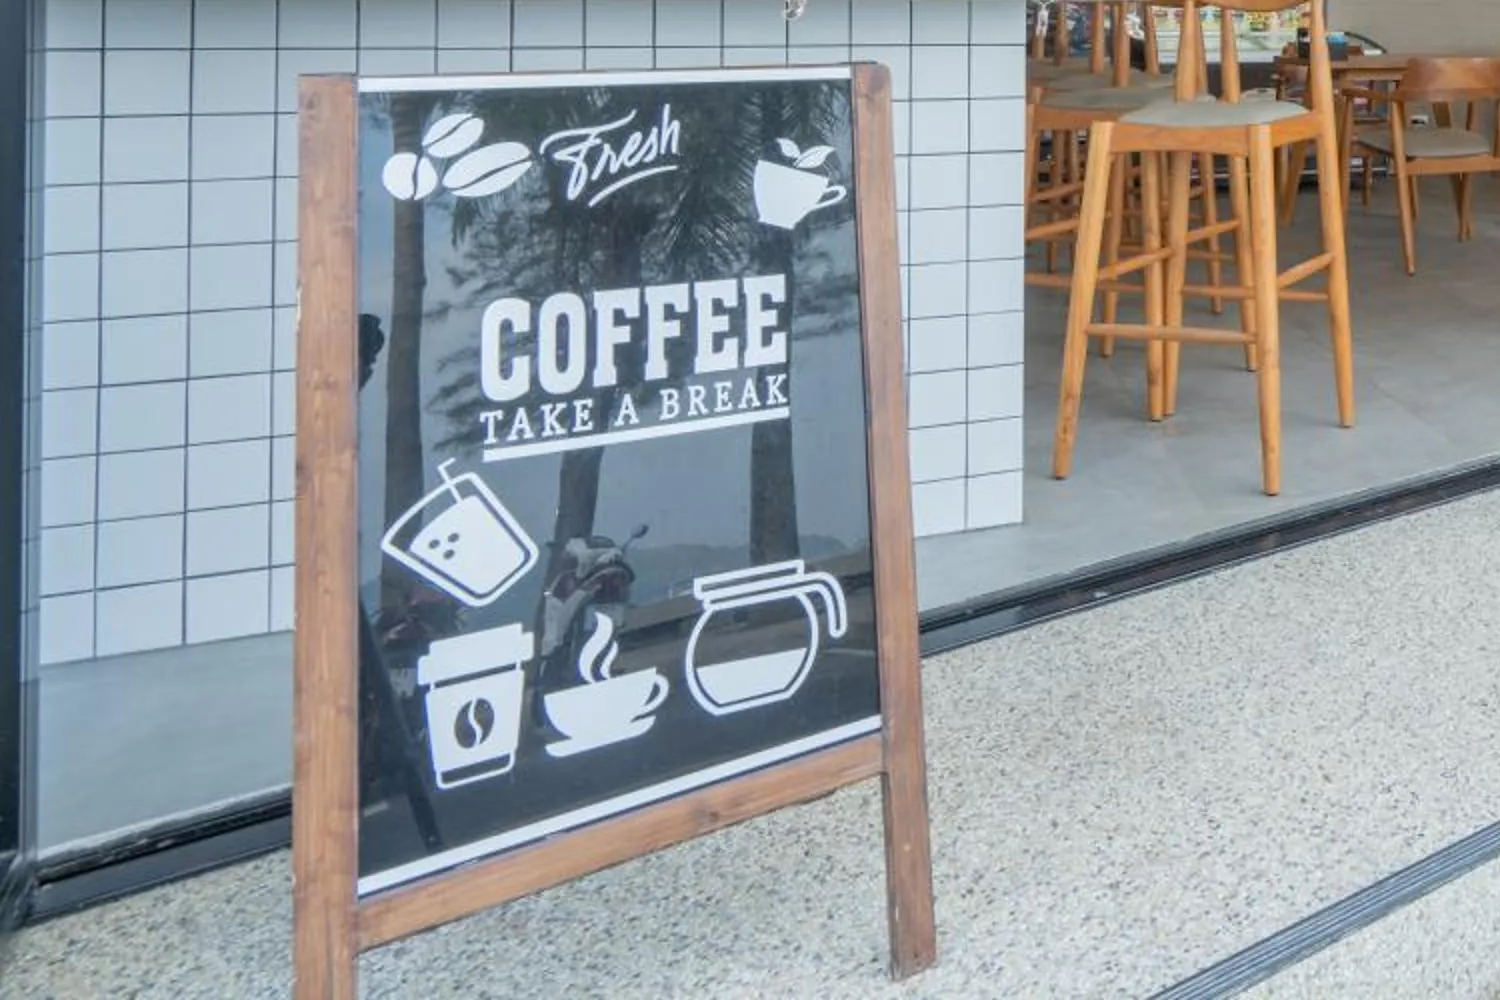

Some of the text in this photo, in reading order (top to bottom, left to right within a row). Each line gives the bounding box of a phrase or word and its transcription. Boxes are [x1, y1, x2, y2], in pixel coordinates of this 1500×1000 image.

[539, 103, 681, 201] Fresh
[480, 273, 787, 402] COFFEE
[479, 373, 788, 445] TAKE A BREAK
